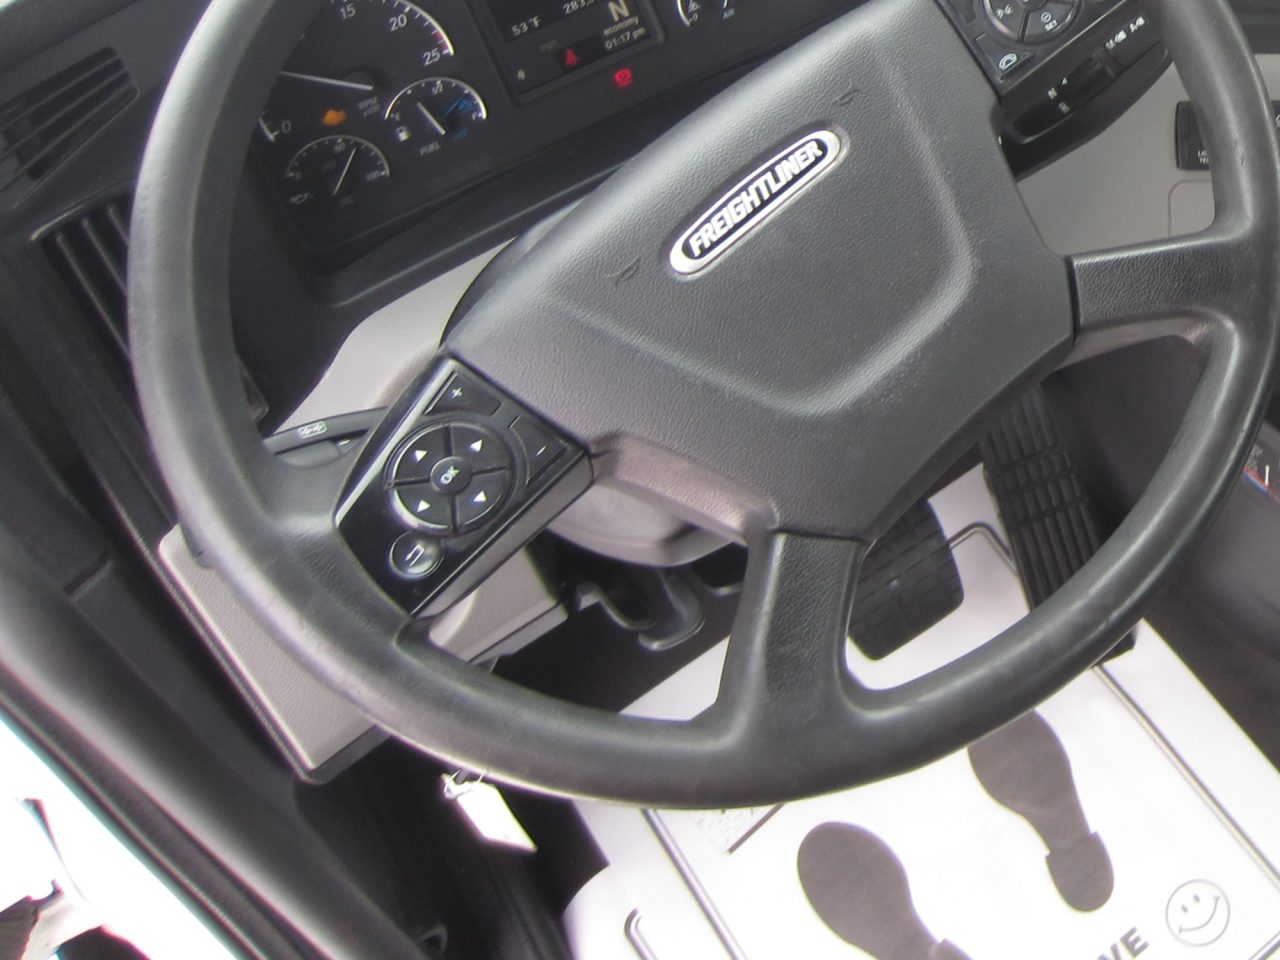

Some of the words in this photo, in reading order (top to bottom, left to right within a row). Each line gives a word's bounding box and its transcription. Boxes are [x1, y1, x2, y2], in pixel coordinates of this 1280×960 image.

[340, 4, 356, 19] 15
[389, 14, 407, 32] 20
[423, 48, 440, 66] 25
[688, 140, 823, 258] FREIGHTLINER
[440, 465, 460, 485] OK
